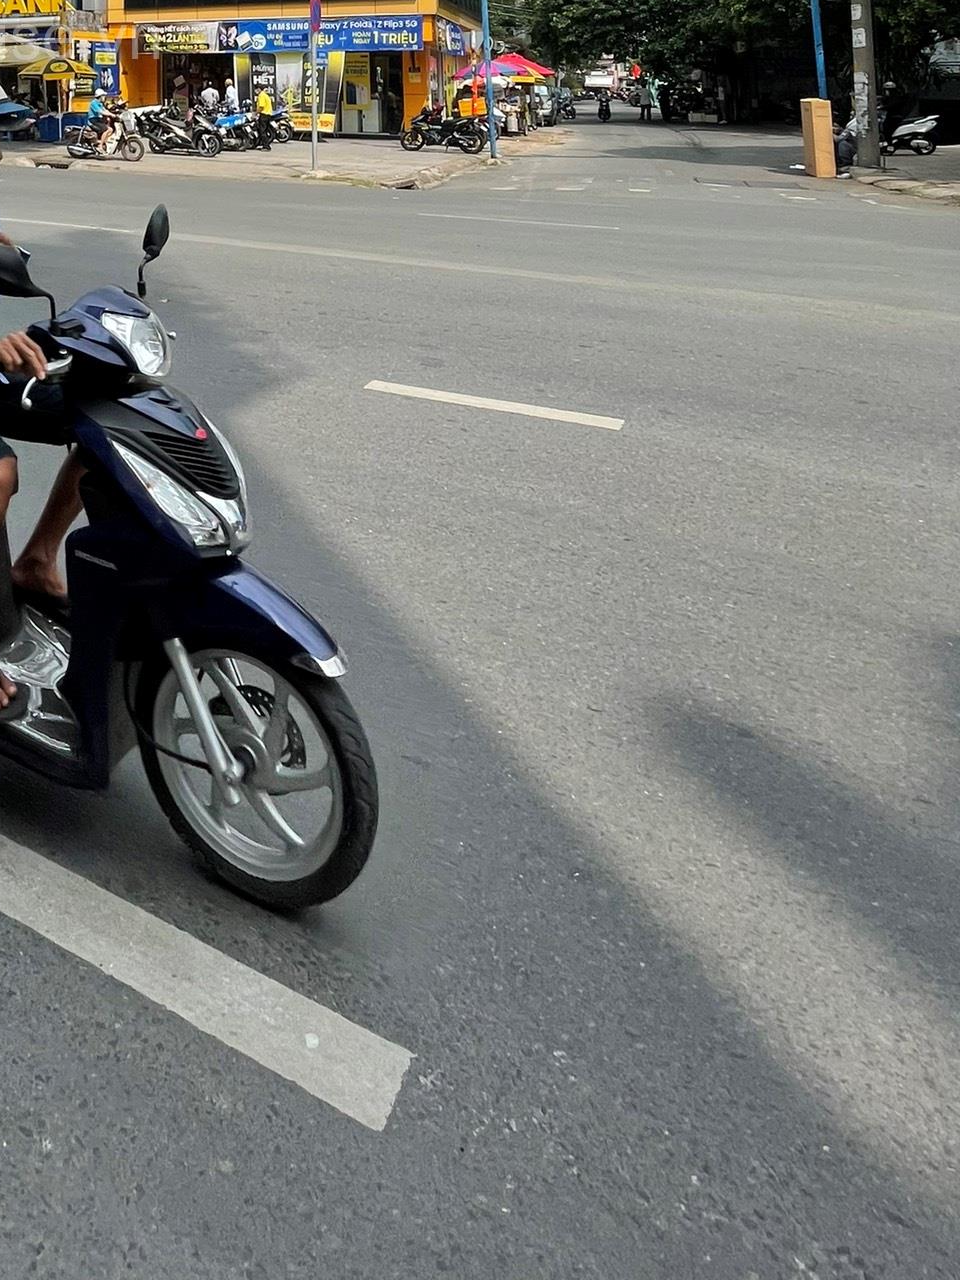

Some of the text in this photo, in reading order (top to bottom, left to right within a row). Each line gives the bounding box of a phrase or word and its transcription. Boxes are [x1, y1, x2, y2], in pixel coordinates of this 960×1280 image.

[267, 22, 309, 31] SAMSUNG
[343, 21, 348, 29] Z
[383, 20, 404, 29] Flip3
[405, 20, 418, 28] 5G
[373, 30, 417, 48] 1 TRIỆU
[253, 73, 275, 85] HẾT
